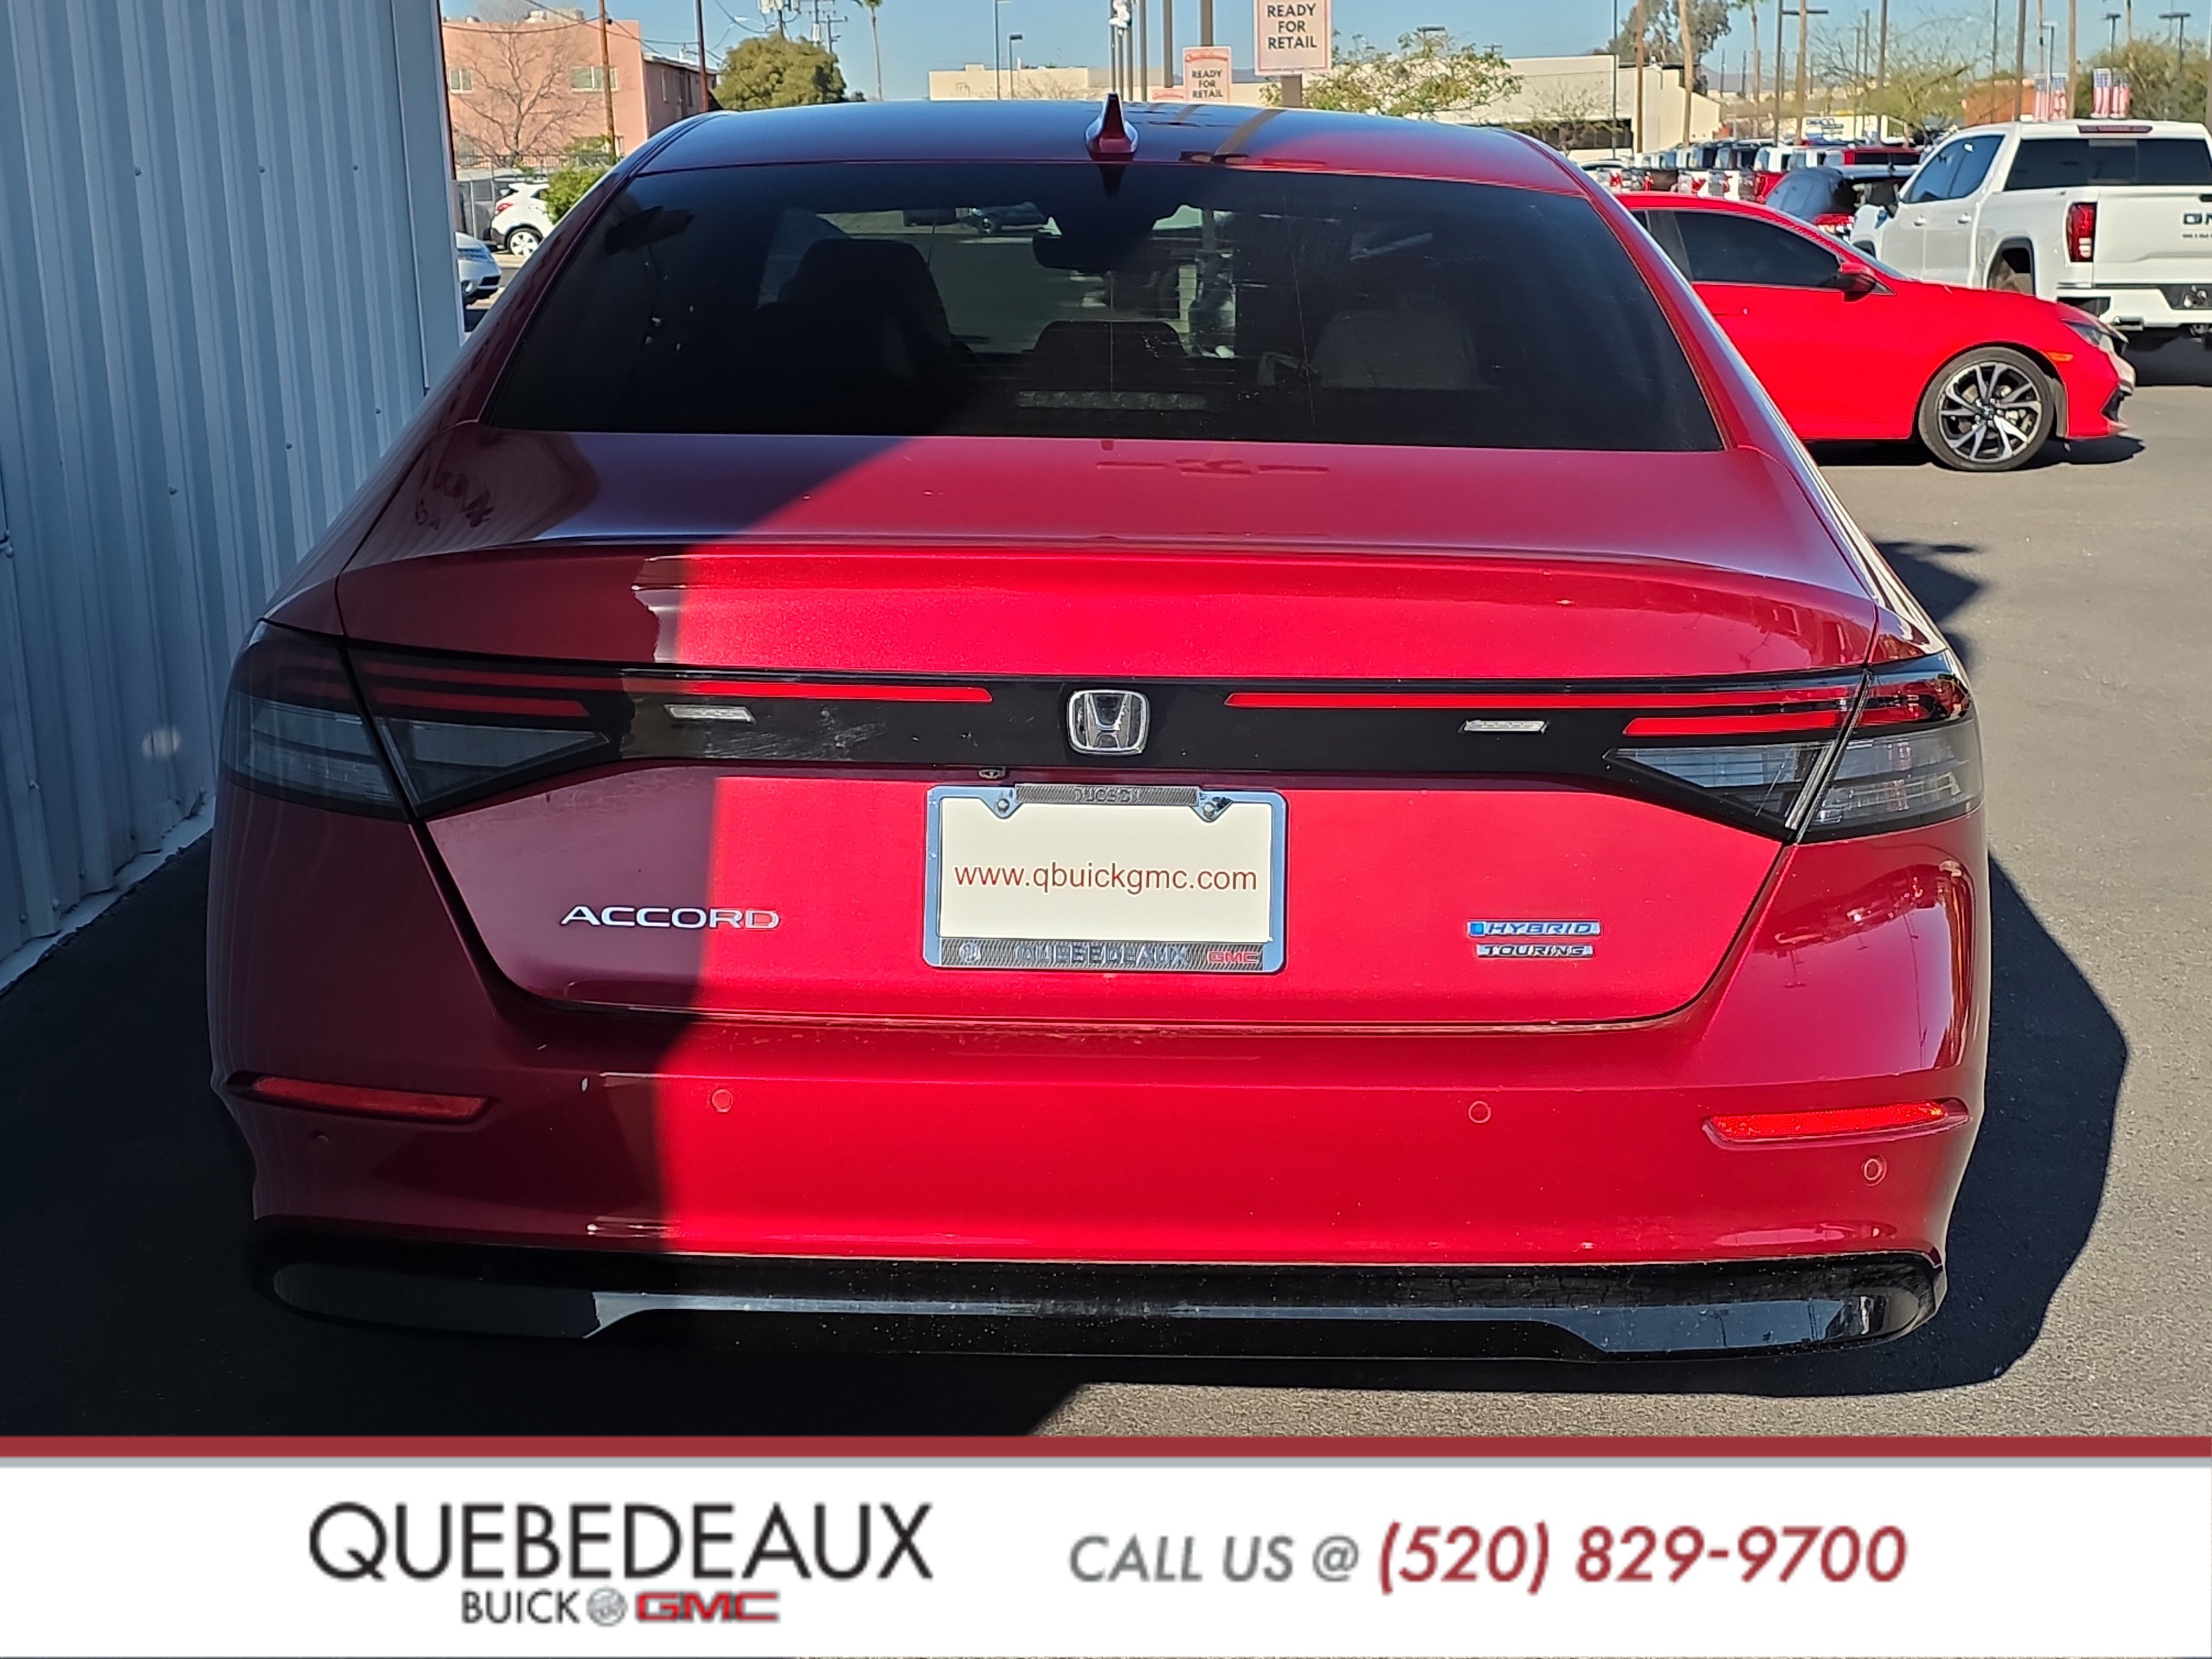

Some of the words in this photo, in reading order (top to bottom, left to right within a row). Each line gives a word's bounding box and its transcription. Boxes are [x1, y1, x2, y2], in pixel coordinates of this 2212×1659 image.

[1267, 3, 1316, 18] READY
[1278, 21, 1306, 33] FOR
[1268, 36, 1317, 49] RETAIL
[1191, 69, 1223, 78] READY
[1198, 80, 1216, 88] FOR
[1192, 90, 1223, 98] RETAIL
[954, 862, 1256, 895] www.qbuickgmc.com
[560, 905, 781, 930] ACCORD
[1487, 922, 1593, 934] HYBRID
[1015, 942, 1189, 966] QUEBEDEAUX
[1207, 950, 1259, 964] GMC
[1484, 946, 1585, 956] TOURING
